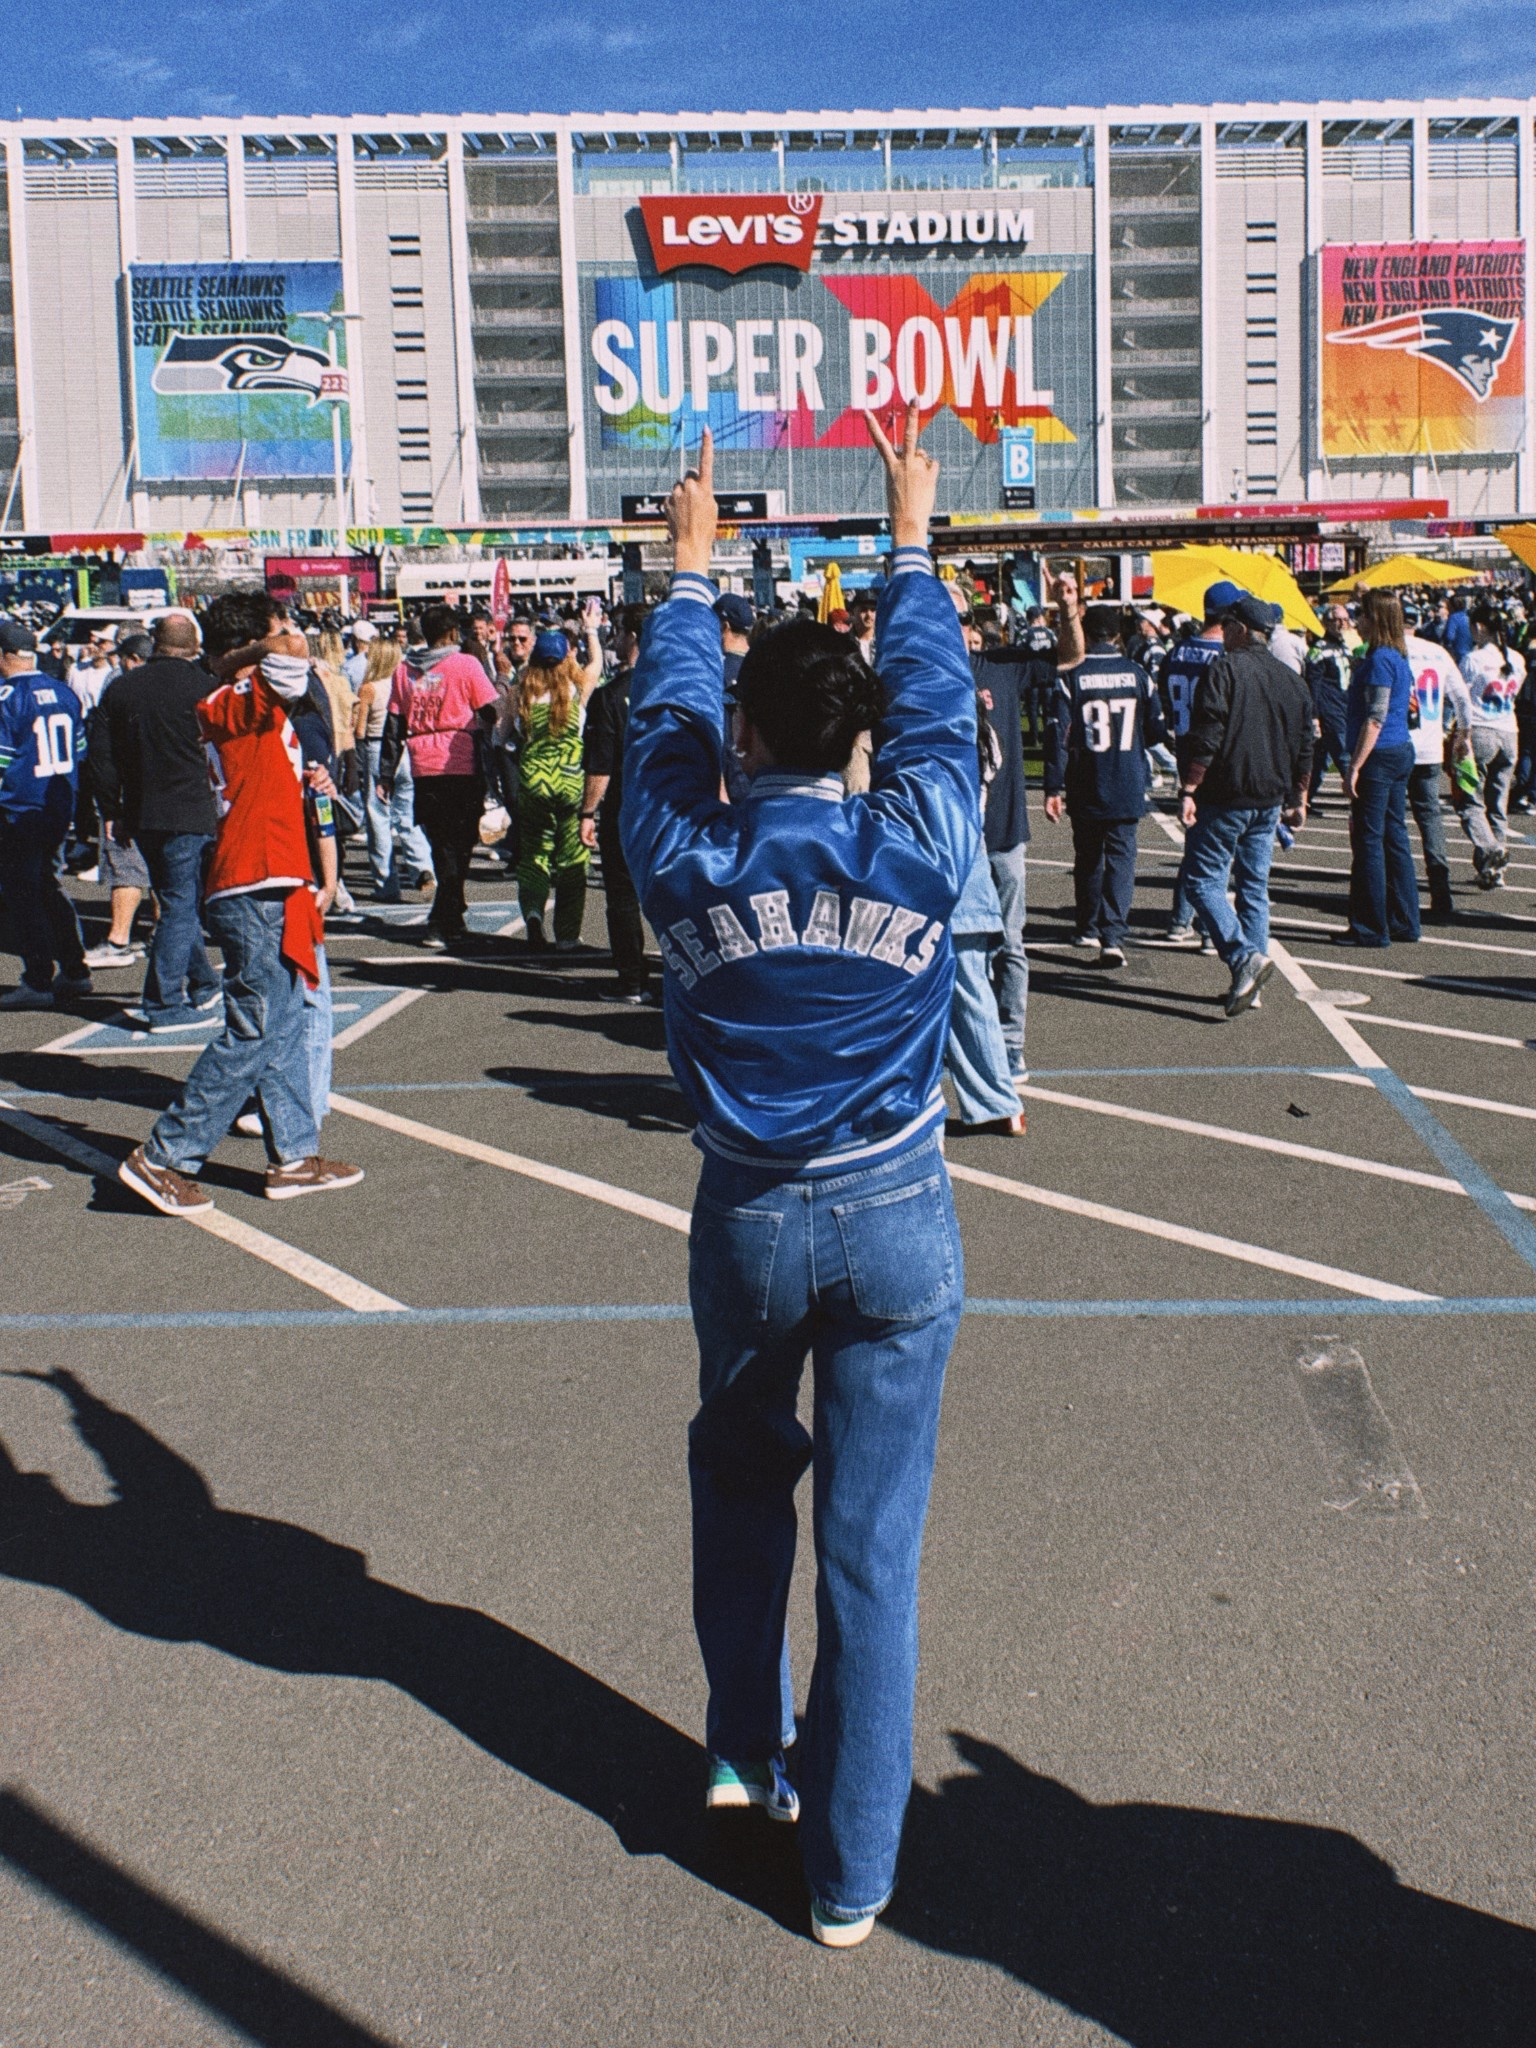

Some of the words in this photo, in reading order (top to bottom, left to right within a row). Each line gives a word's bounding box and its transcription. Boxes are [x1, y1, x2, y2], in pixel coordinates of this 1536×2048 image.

[833, 208, 1034, 247] STADIUM
[1342, 257, 1378, 280] NEW
[1381, 255, 1452, 279] ENGLAND
[1455, 252, 1526, 277] PATRIOTS
[132, 276, 194, 299] SEATTLE
[198, 275, 286, 298] SEAHAWKS
[1342, 280, 1377, 304] NEW
[1381, 279, 1451, 303] ENGLAND
[1454, 276, 1526, 301] PATRIOTS
[132, 300, 195, 322] SEATTLE
[198, 298, 287, 321] SEAHAWKS
[1341, 303, 1378, 327] NEW
[591, 319, 824, 415] SUPER
[849, 315, 1055, 412] BOWL
[1010, 444, 1030, 480] B
[249, 529, 281, 547] SAN
[287, 528, 378, 548] FRANCSCO
[958, 543, 1026, 552] CALIFORNIA
[1083, 541, 1124, 549] CABLE
[1235, 536, 1300, 544] FRANCISCO
[425, 580, 467, 590] BAR
[540, 577, 576, 586] BAY
[1082, 697, 1137, 752] 87
[32, 712, 74, 778] 10
[660, 889, 944, 991] SEAHAWKS
